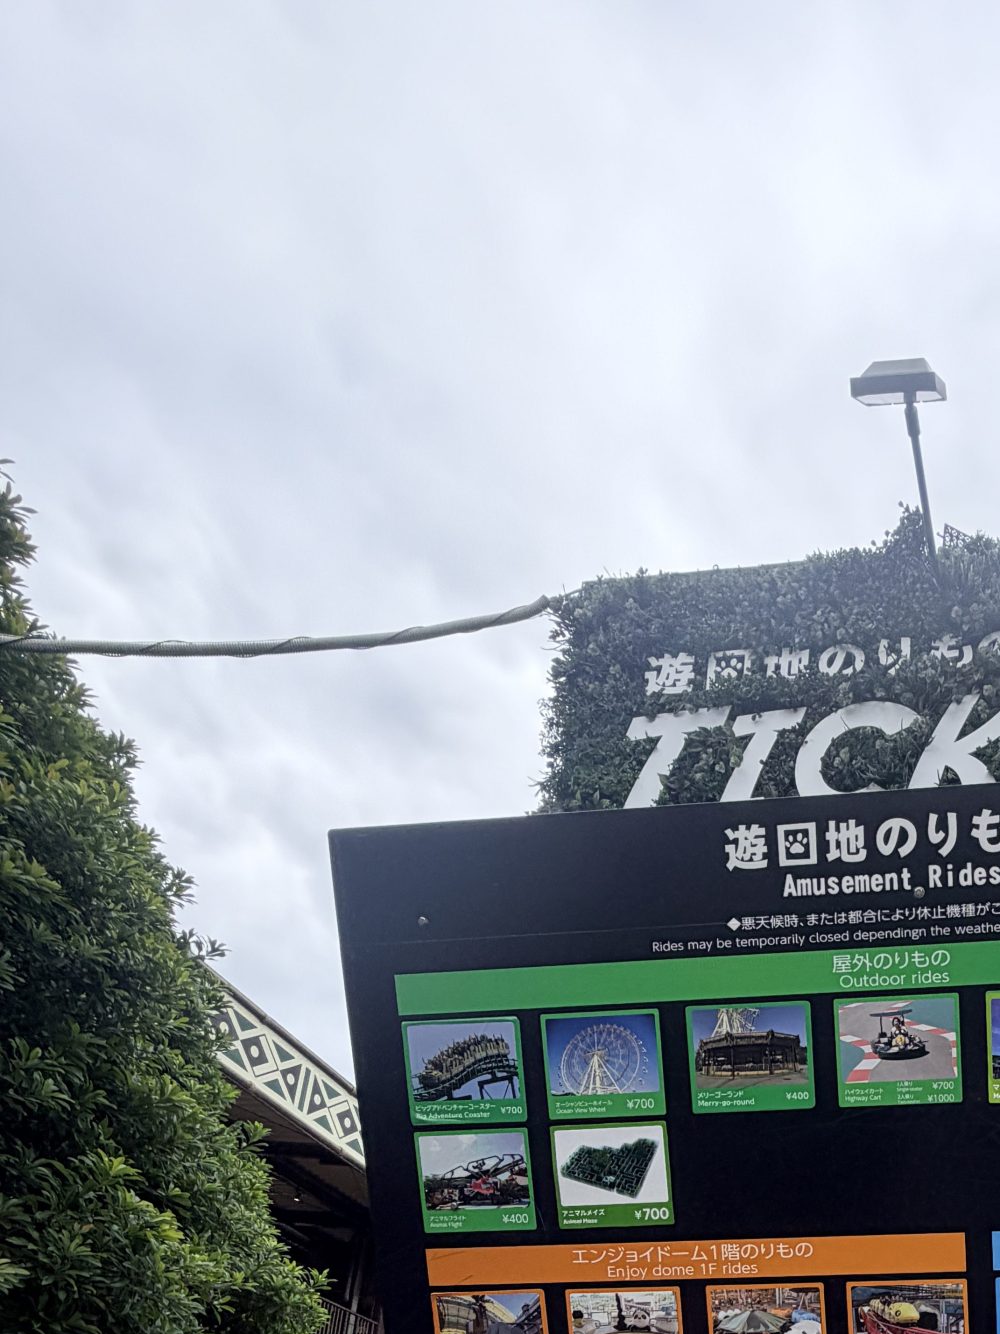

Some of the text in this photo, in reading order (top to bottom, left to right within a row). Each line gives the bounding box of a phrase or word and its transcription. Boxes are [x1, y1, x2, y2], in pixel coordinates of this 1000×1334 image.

[783, 868, 912, 897] Amusement
[652, 941, 684, 952] Rides
[687, 941, 713, 952] may
[716, 938, 732, 949] be
[736, 933, 806, 949] temporarily
[809, 931, 849, 944] closed
[853, 927, 927, 943] dependingn
[930, 926, 951, 937] the
[832, 950, 951, 974] 屋外のりもの
[839, 971, 950, 988] Outdoor rides
[932, 1082, 955, 1090] ¥700
[785, 1091, 810, 1101] ¥400
[927, 1093, 955, 1104] ¥1000
[626, 1098, 655, 1109] ¥700
[501, 1106, 523, 1115] ¥700
[502, 1213, 529, 1224] ¥400
[634, 1207, 670, 1220] ¥700
[572, 1241, 814, 1265] エンジョイドーム1階のりもの
[607, 1262, 759, 1281] Enjoy dome 1F rides
